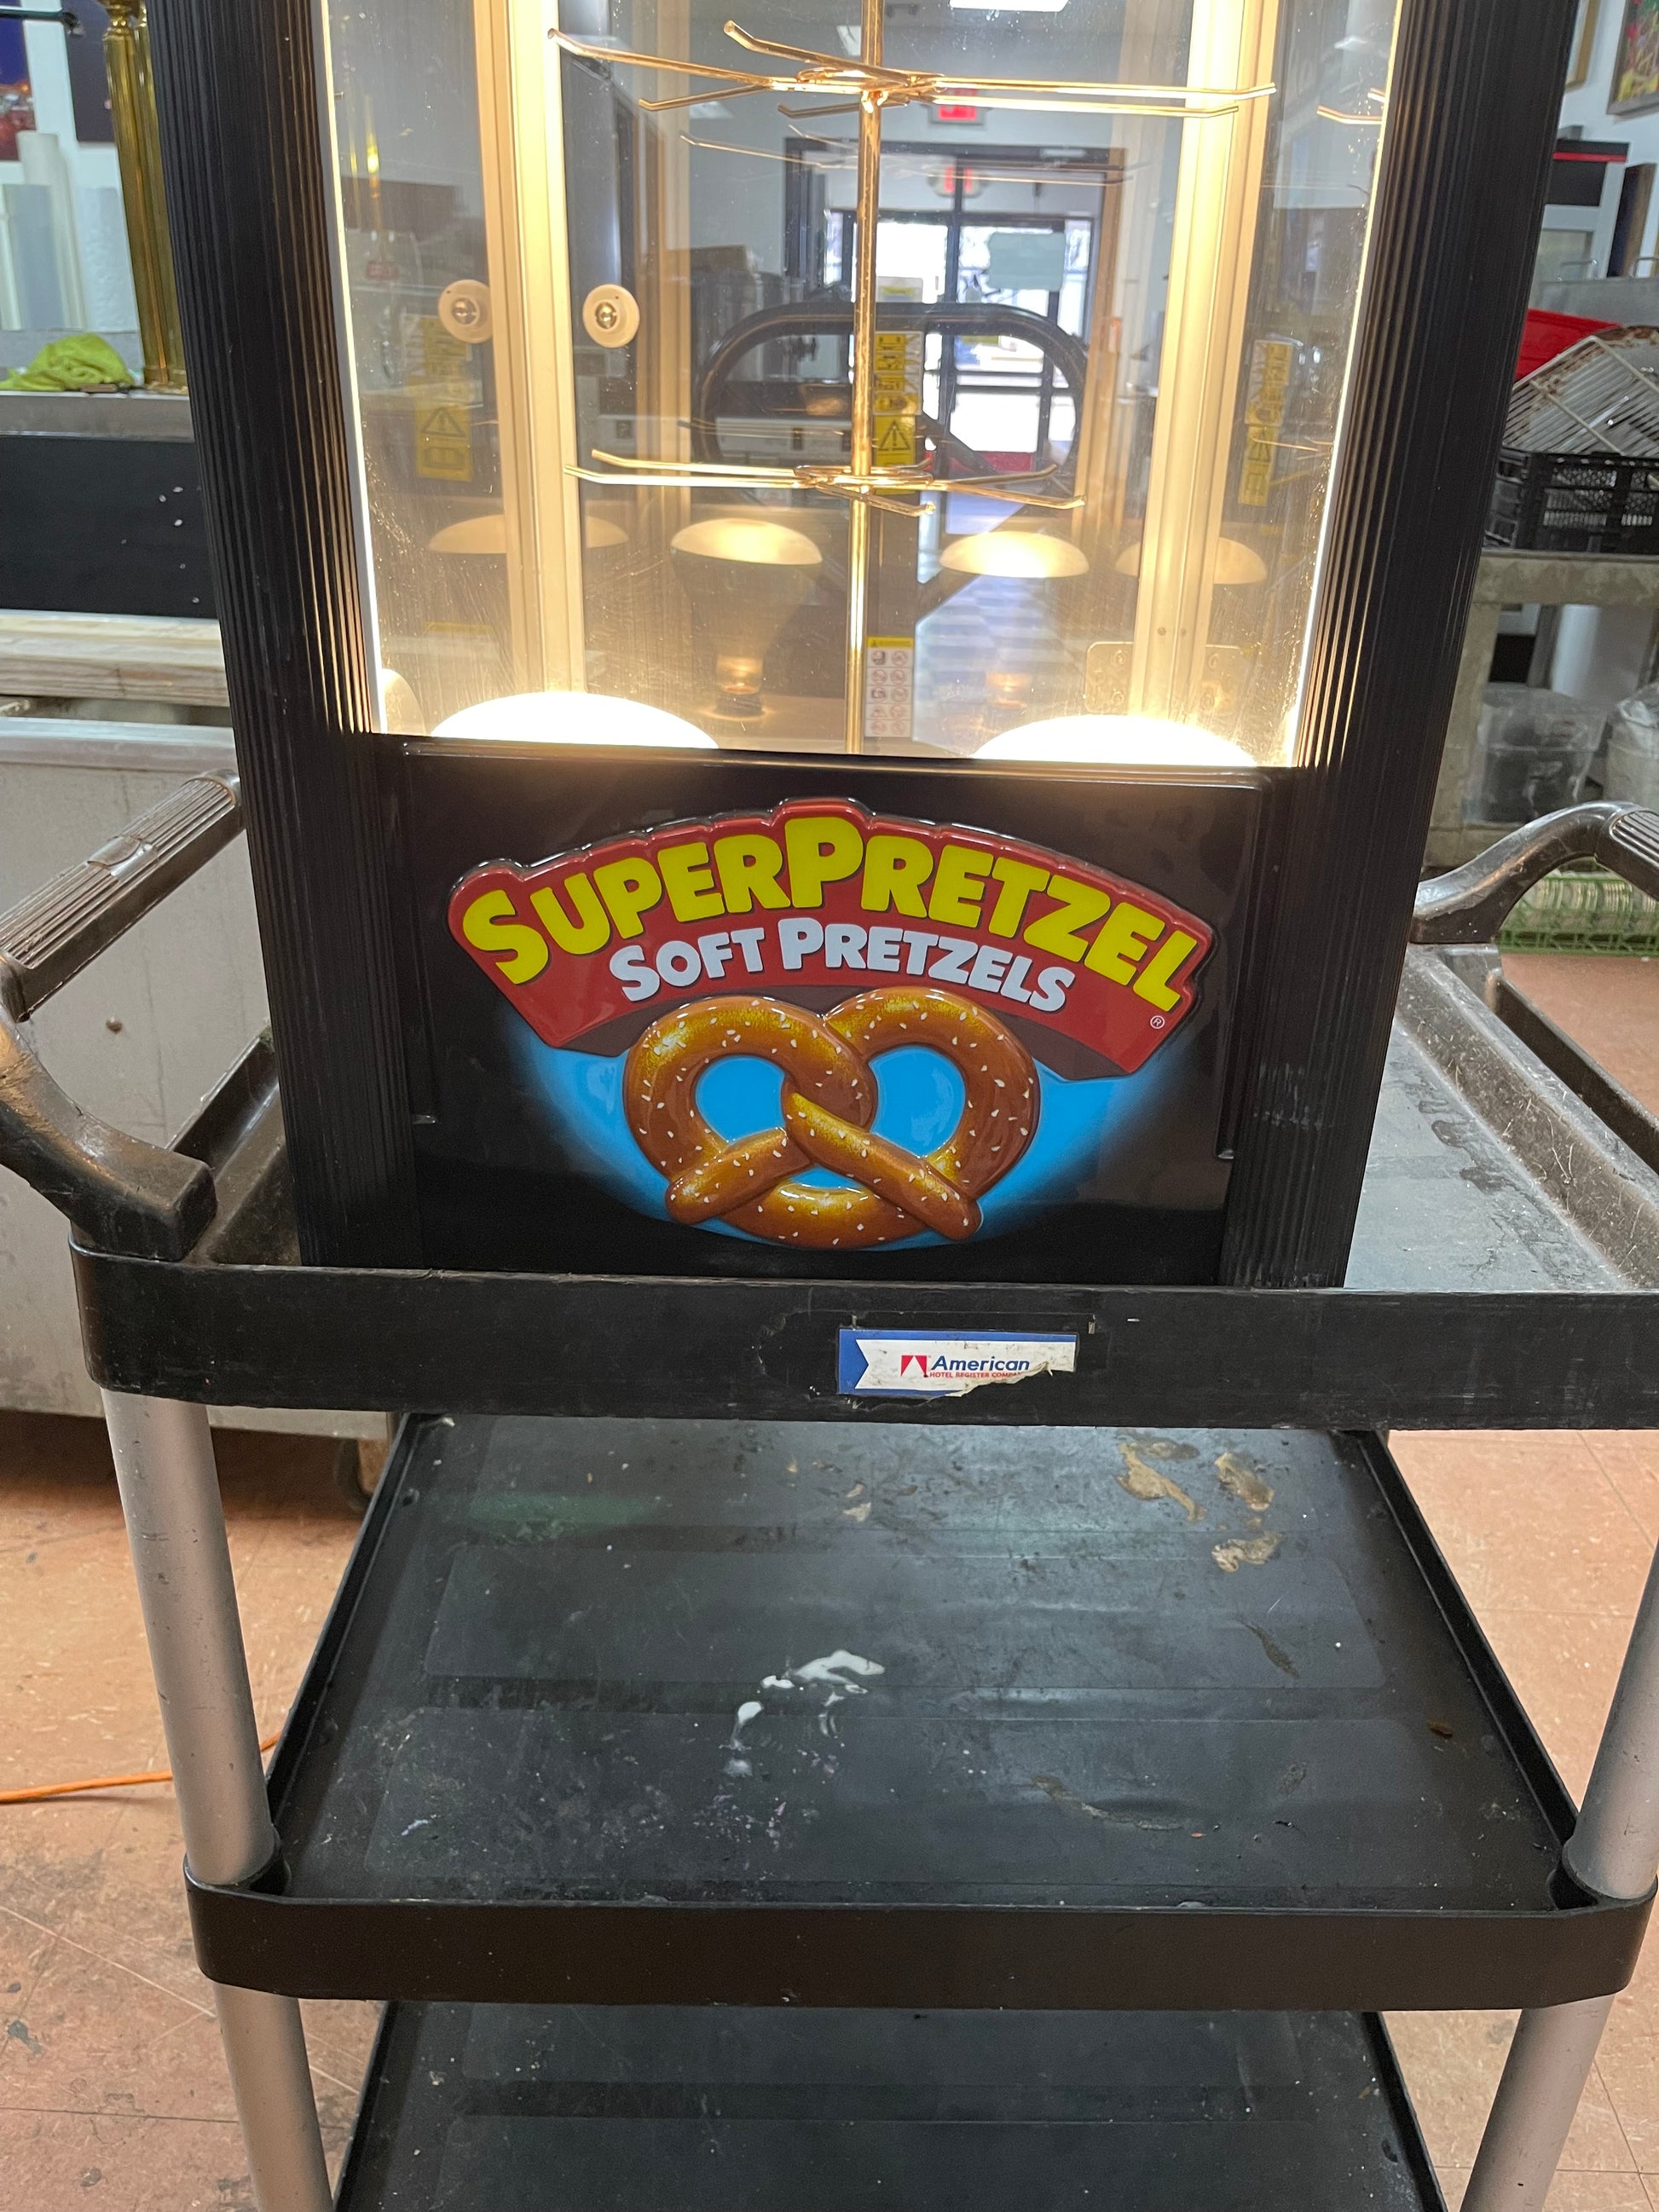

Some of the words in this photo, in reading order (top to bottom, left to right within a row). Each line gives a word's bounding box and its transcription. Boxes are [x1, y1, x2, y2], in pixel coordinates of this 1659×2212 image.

[461, 817, 1198, 1012] SUPERPRETZEL
[609, 927, 765, 1002] SOFT
[779, 917, 1075, 1013] PRETZELS
[931, 1354, 1030, 1372] American
